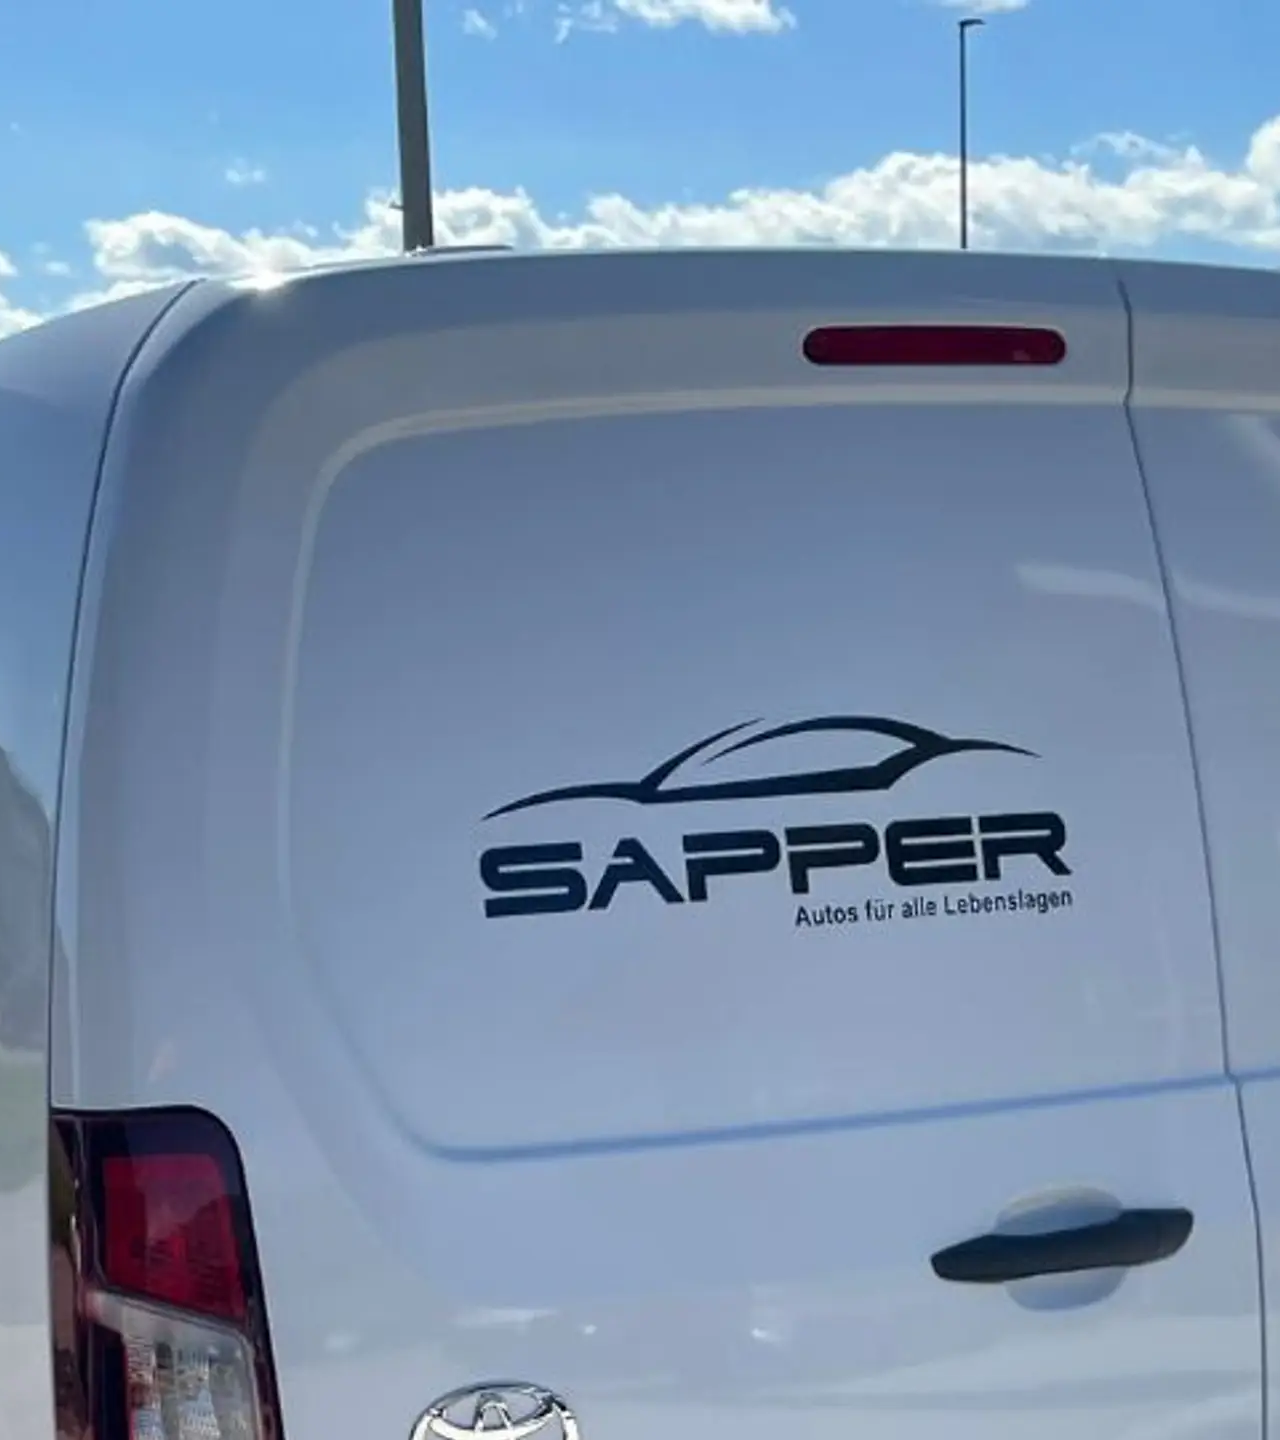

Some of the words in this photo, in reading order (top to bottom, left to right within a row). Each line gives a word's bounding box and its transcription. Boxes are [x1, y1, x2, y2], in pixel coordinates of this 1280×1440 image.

[480, 811, 1072, 918] SAPPER
[795, 905, 858, 927] Autos
[866, 898, 895, 921] für
[901, 895, 937, 919] alle
[944, 889, 1073, 916] Lebenslagen
